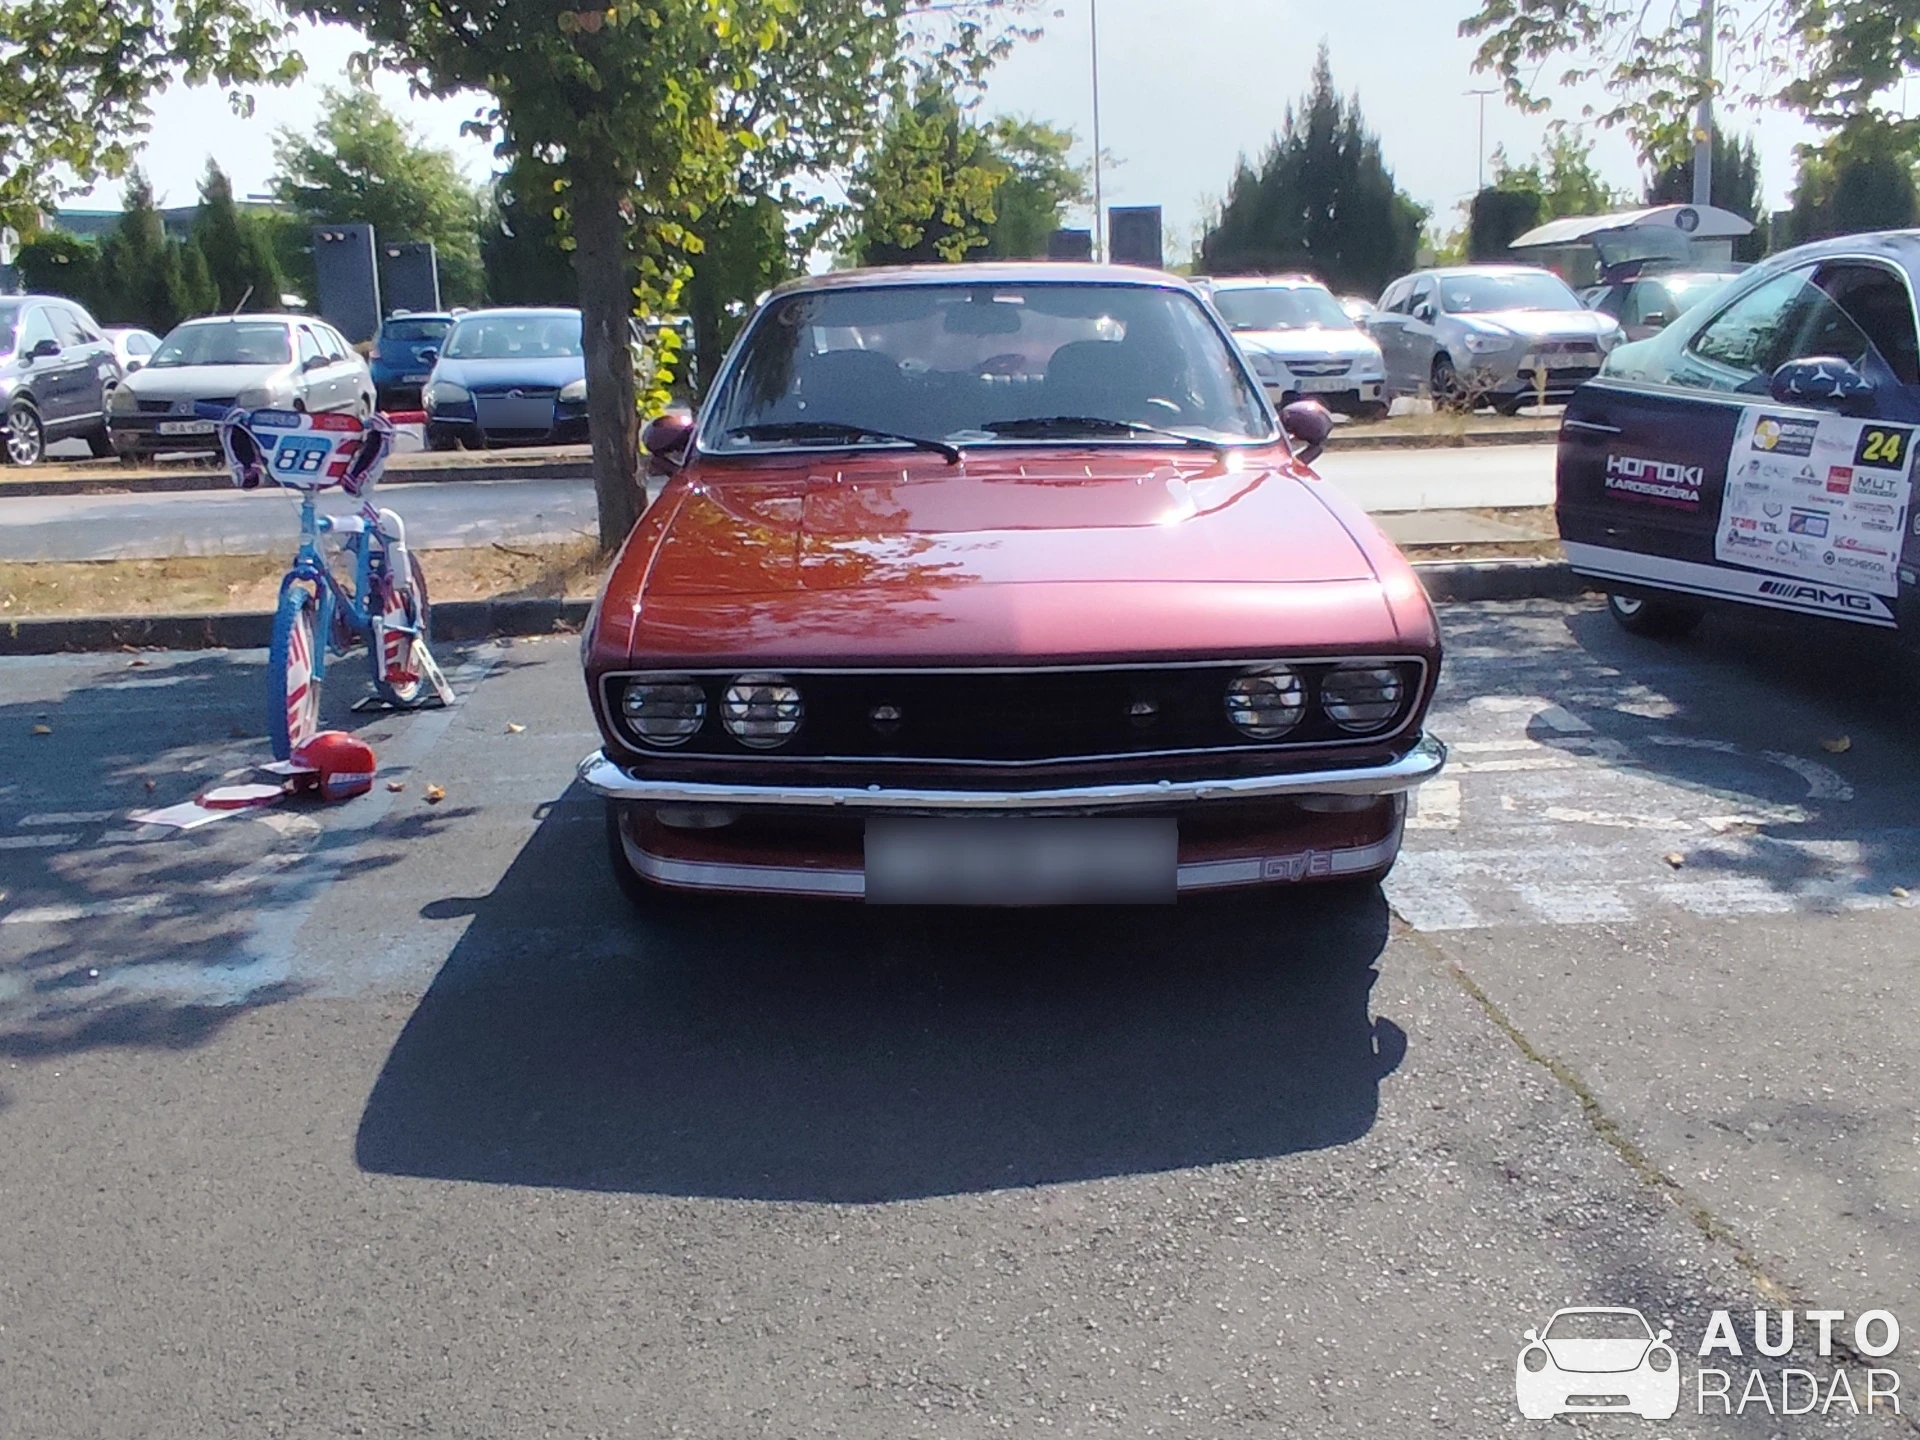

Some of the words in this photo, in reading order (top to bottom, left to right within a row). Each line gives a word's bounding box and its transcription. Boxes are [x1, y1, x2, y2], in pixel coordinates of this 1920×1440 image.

[1862, 430, 1901, 463] 24
[275, 448, 327, 472] 88
[1604, 477, 1700, 502] KAROSSZÉRIA
[1858, 475, 1897, 491] MUT
[1794, 586, 1872, 611] AMG
